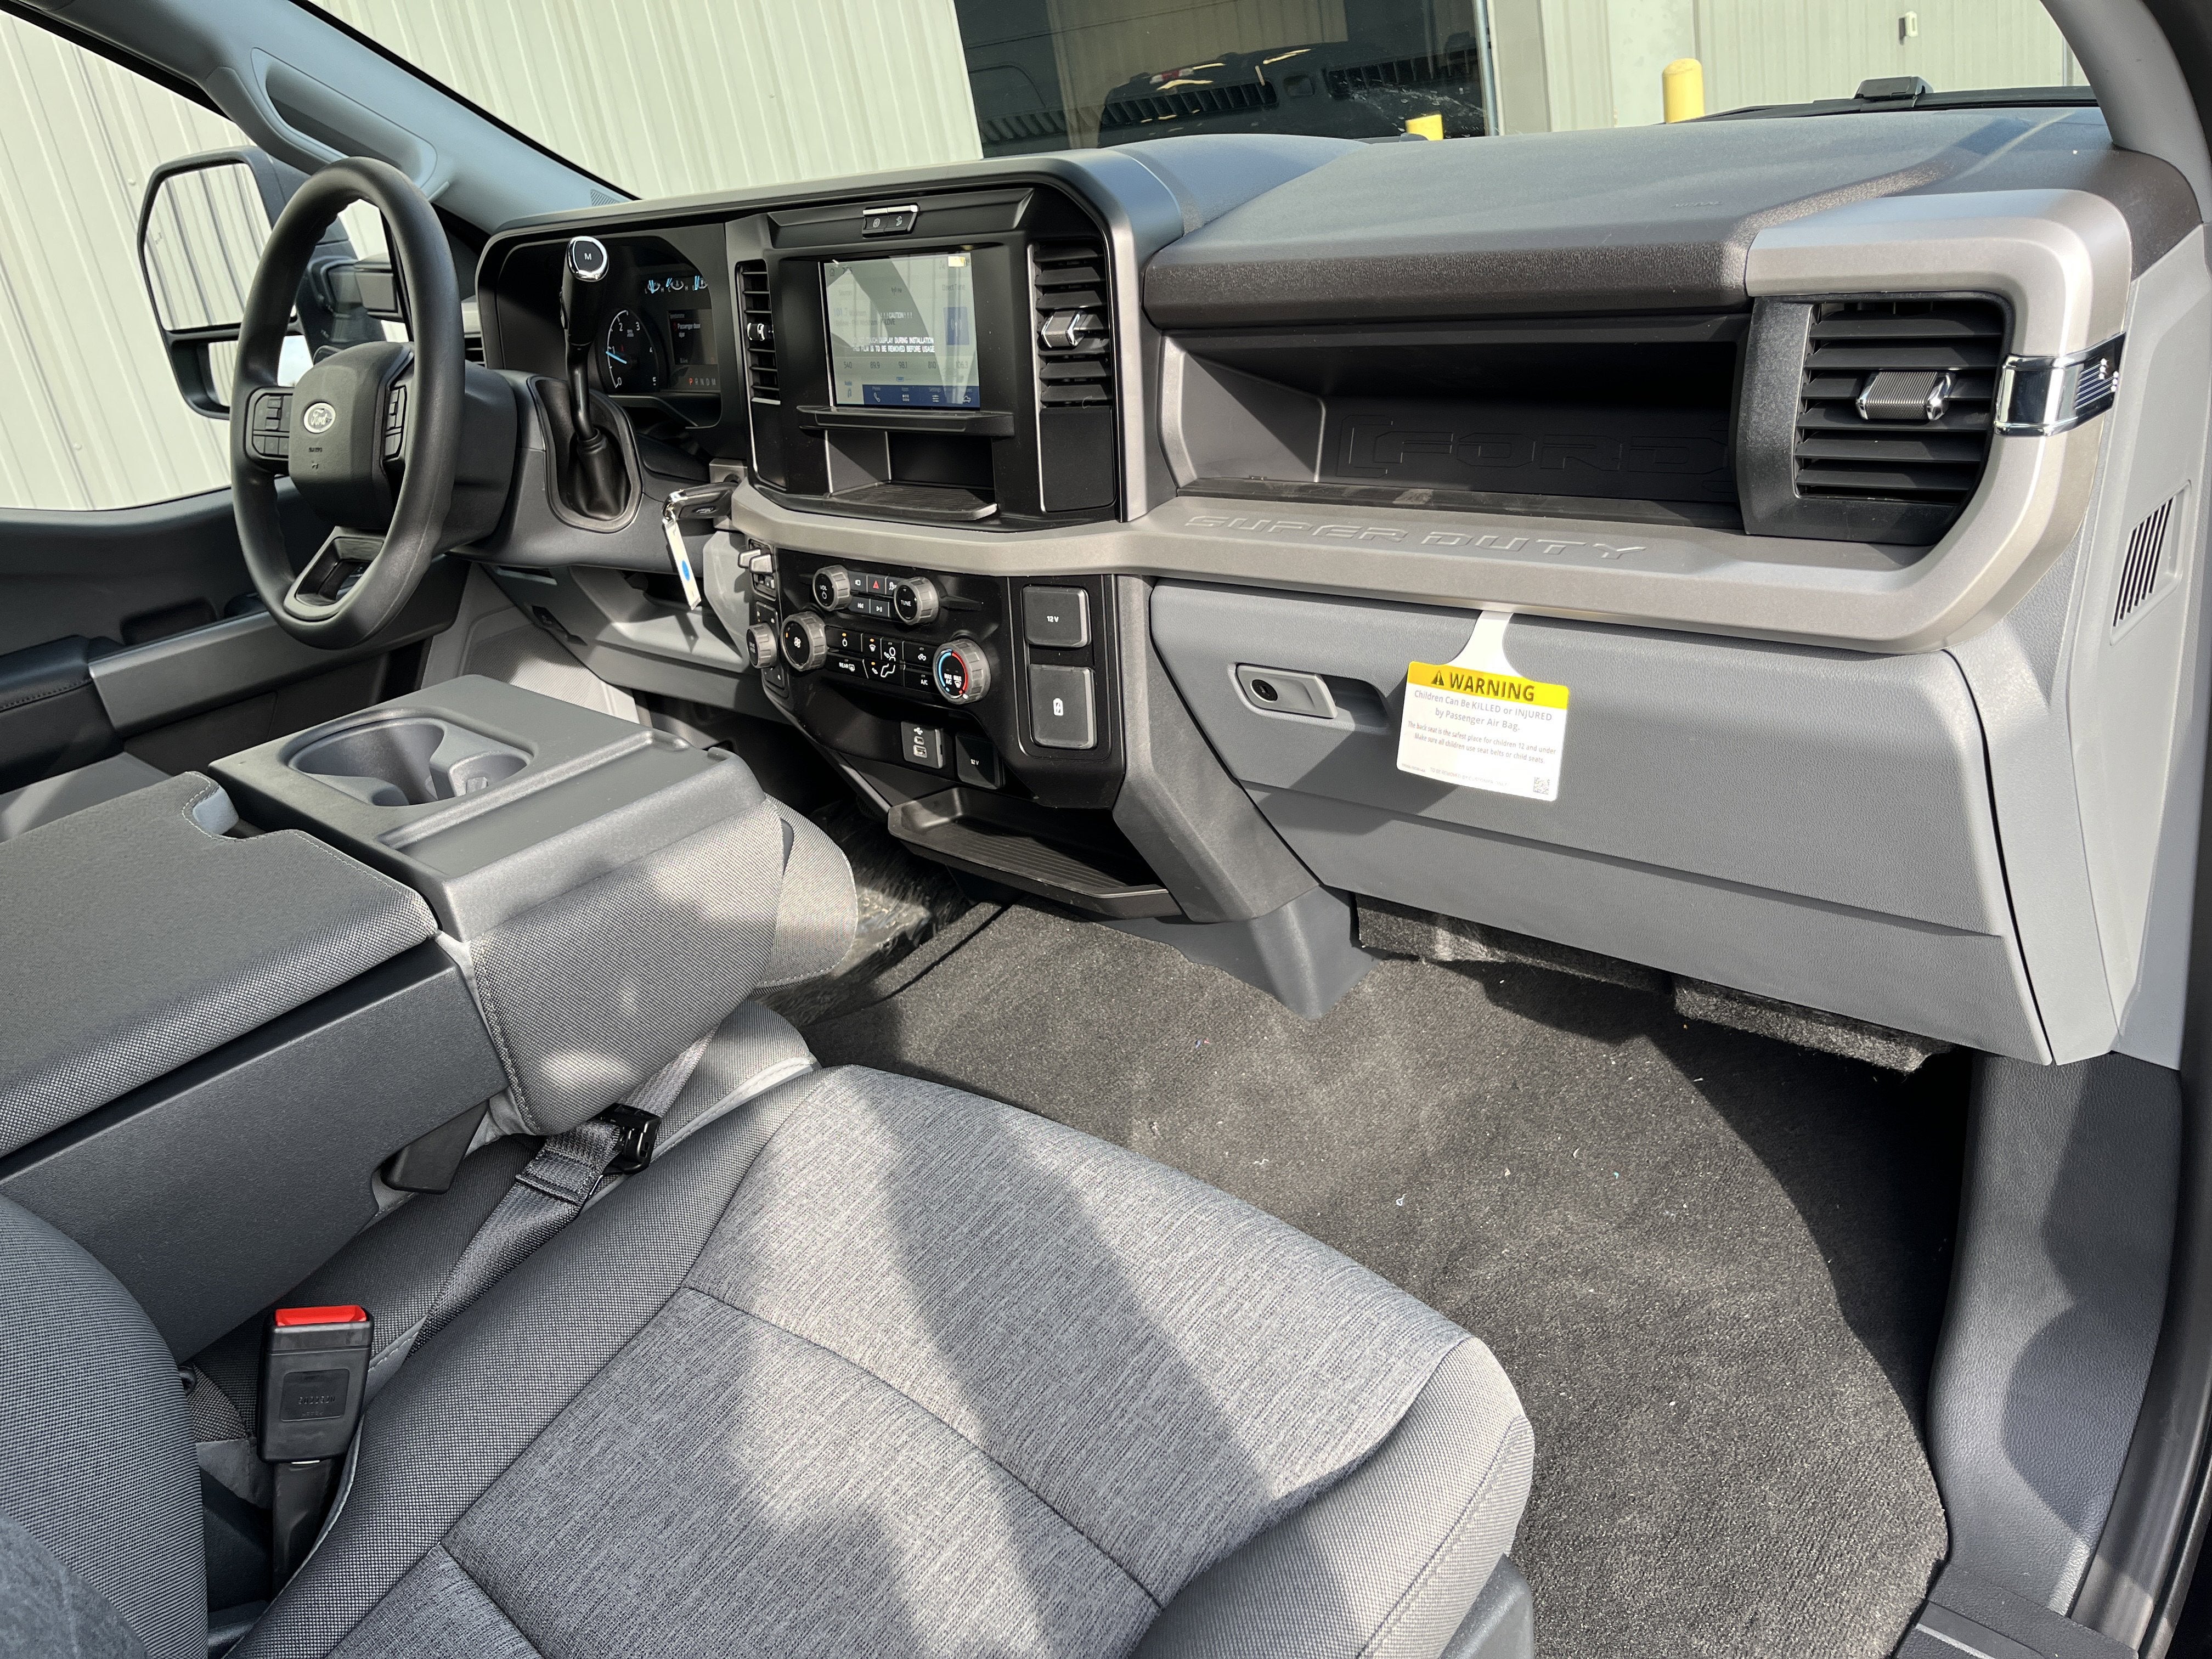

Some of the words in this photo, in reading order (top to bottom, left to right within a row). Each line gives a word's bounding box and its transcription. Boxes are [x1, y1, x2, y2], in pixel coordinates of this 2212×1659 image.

[618, 322, 623, 331] 2
[635, 321, 640, 331] 3
[689, 377, 693, 386] P
[1373, 430, 1728, 475] FORD
[1184, 515, 1409, 543] SUPER
[1420, 531, 1647, 560] DUTY
[1449, 672, 1535, 702] WARNING
[1414, 689, 1443, 703] Children
[1445, 696, 1459, 706] Can
[1460, 698, 1471, 709] Be
[1471, 701, 1501, 713] KILLED
[1515, 708, 1553, 721] INJURED
[1435, 707, 1444, 719] by
[1445, 710, 1485, 725] Passenger
[1487, 718, 1500, 727] Air
[1502, 720, 1520, 732] Bag.
[1408, 720, 1416, 729] The
[1417, 722, 1427, 731] back
[1443, 729, 1451, 737] the
[1452, 731, 1467, 741] safest
[1467, 735, 1482, 743] place
[1493, 738, 1516, 748] children
[1538, 747, 1556, 755] under
[1414, 732, 1427, 742] Make
[1427, 736, 1437, 744] sure
[1445, 740, 1465, 751] children
[1477, 747, 1489, 755] seat
[1490, 748, 1504, 757] belts
[1513, 752, 1527, 760] child
